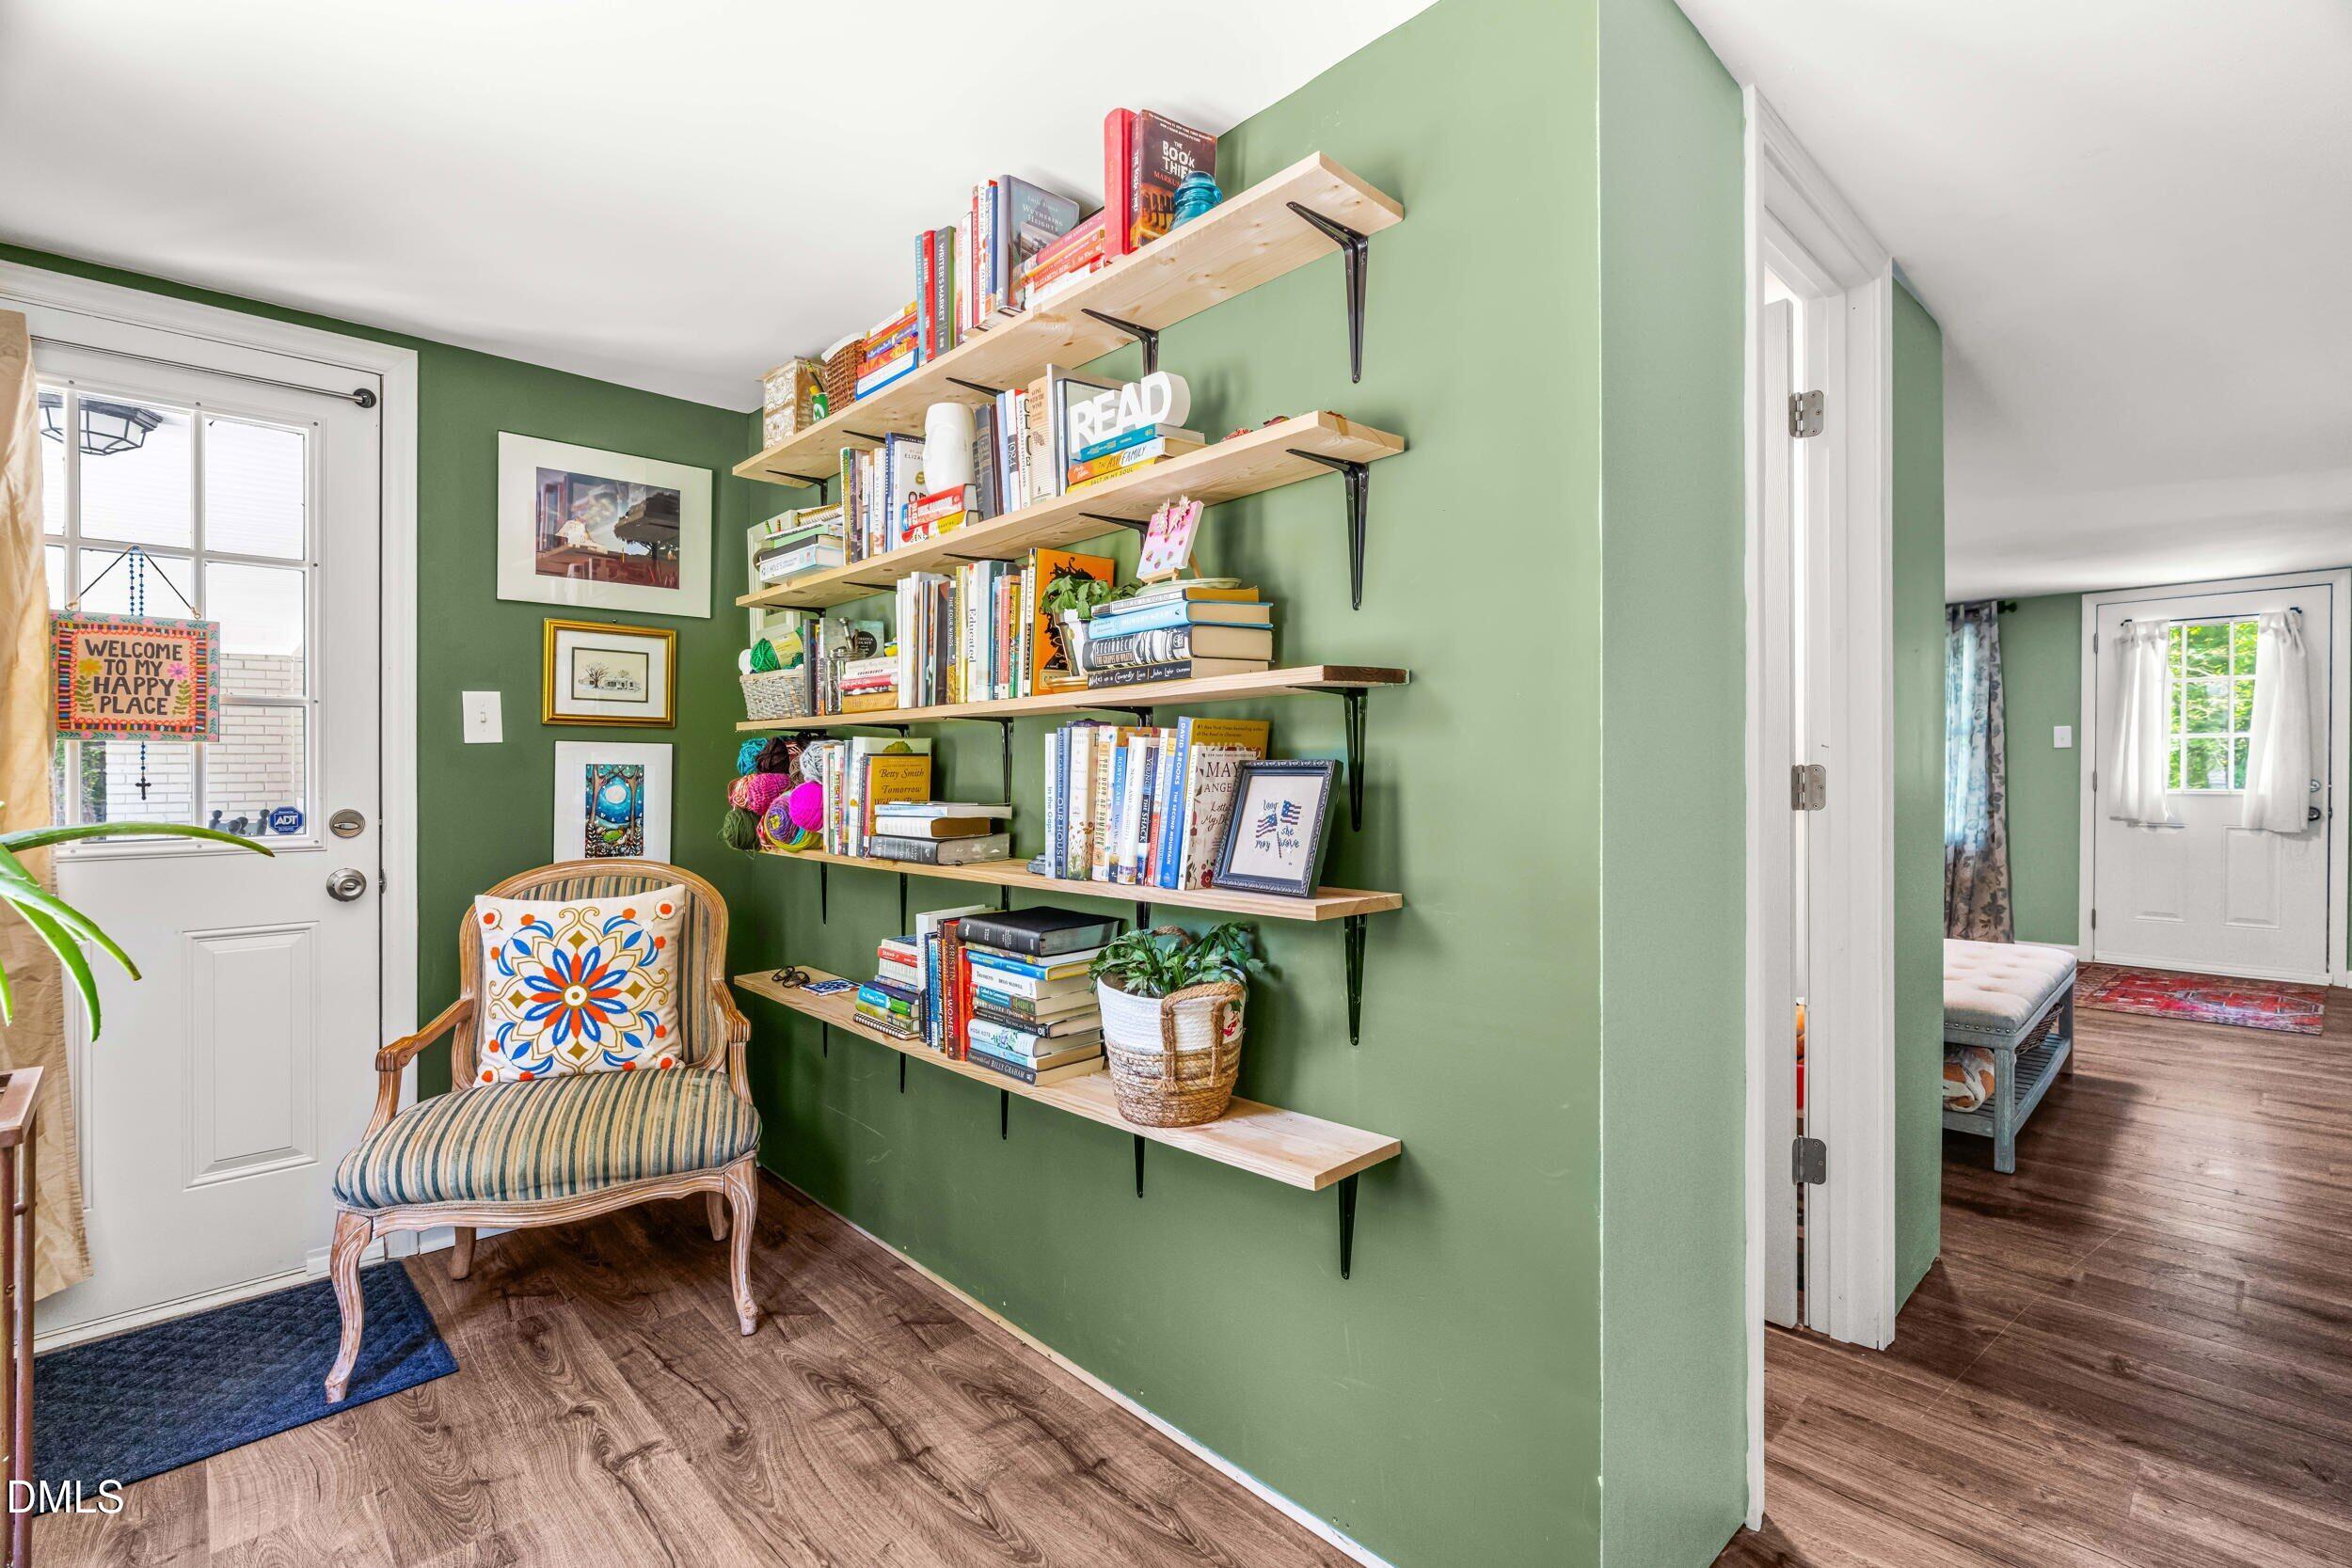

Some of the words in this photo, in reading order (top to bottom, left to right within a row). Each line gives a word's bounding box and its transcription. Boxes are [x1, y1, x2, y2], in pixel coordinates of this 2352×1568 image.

[1174, 140, 1183, 149] THE
[1162, 140, 1195, 168] BOOK
[1162, 156, 1193, 180] THIE
[1069, 371, 1173, 454] READ
[1008, 440, 1017, 467] 1984
[1106, 454, 1121, 469] ASH
[1120, 445, 1147, 466] FAMILY
[1120, 467, 1134, 476] SOUL
[85, 639, 183, 660] WELCOME
[103, 658, 127, 676] TO
[135, 659, 164, 677] MY
[1114, 671, 1135, 684] Cowardly
[1136, 670, 1147, 681] Lion
[1150, 668, 1163, 678] John
[93, 676, 174, 697] HAPPY
[100, 696, 167, 716] PLACE
[879, 768, 899, 781] Betty
[900, 768, 926, 780] Smith
[881, 784, 923, 795] Tomorrow
[1048, 786, 1053, 795] In
[276, 816, 298, 826] ADT
[1280, 826, 1295, 835] she
[1254, 840, 1271, 852] may
[1279, 837, 1300, 848] wave
[988, 1004, 1005, 1014] OLIVER
[1005, 1018, 1024, 1029] NICHOLAS
[991, 1059, 1005, 1071] BILLY
[1005, 1064, 1025, 1079] GRAHAM
